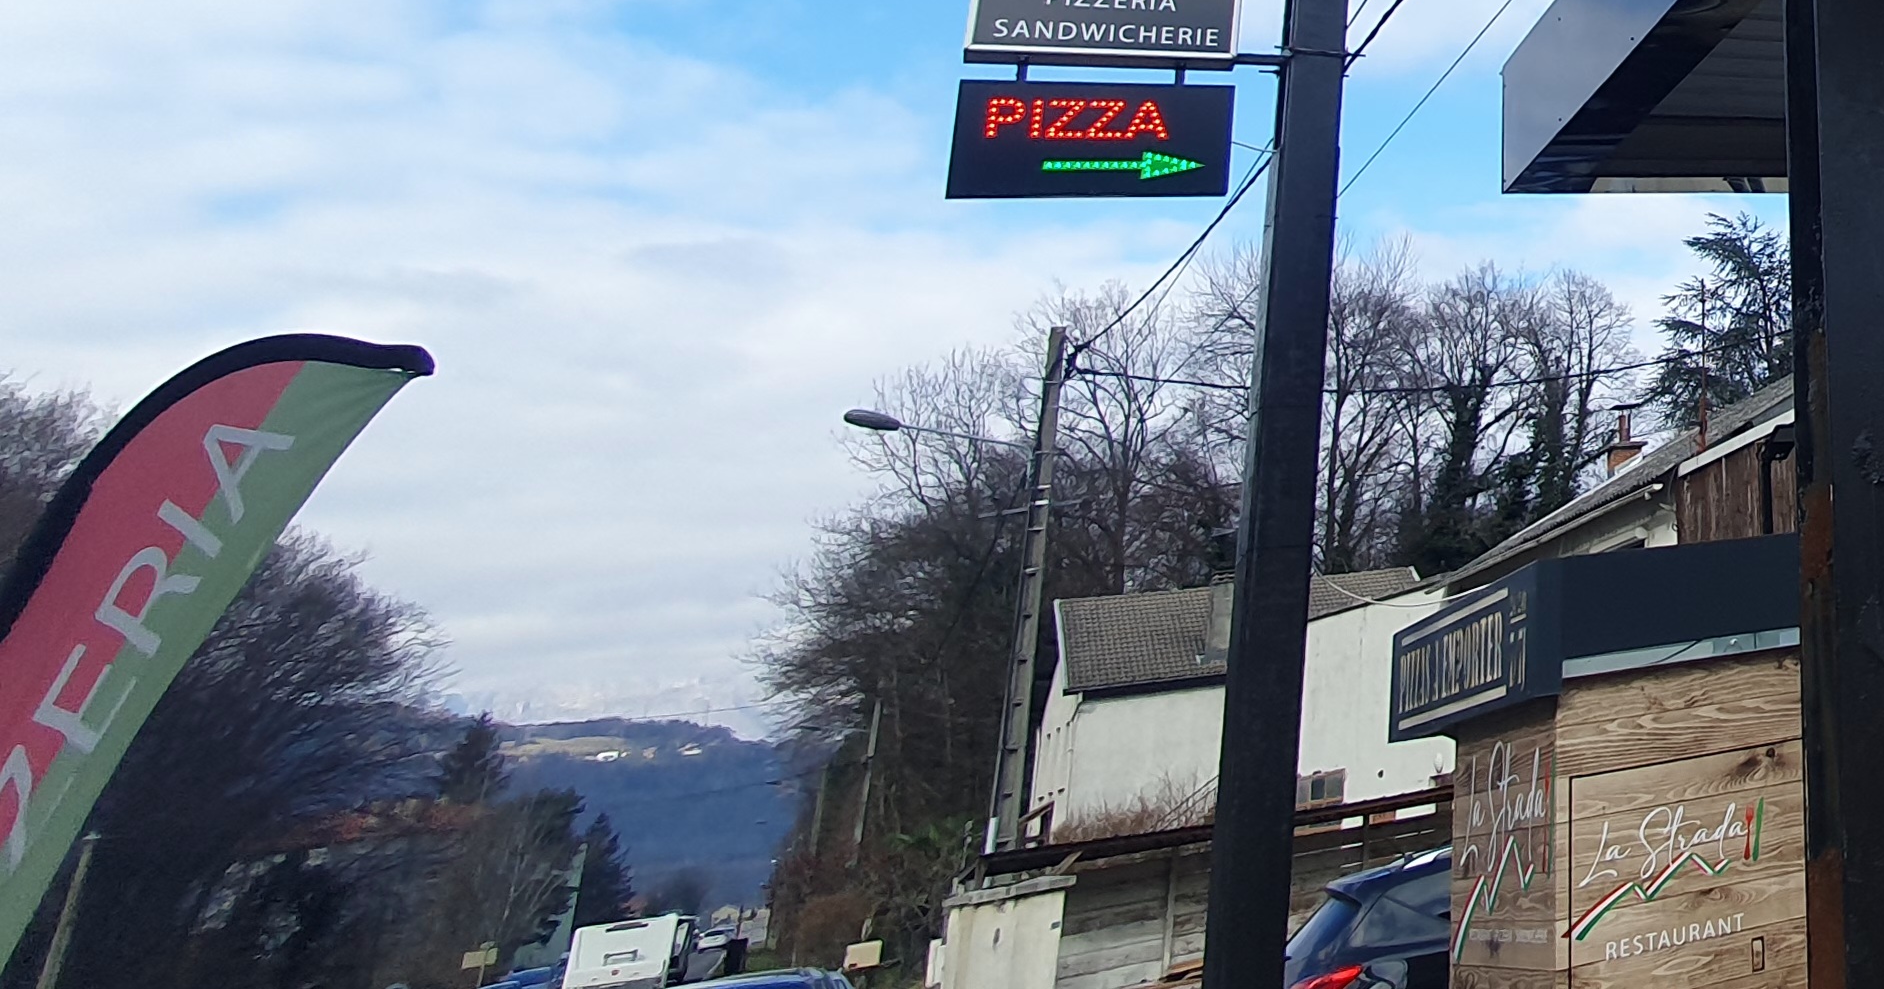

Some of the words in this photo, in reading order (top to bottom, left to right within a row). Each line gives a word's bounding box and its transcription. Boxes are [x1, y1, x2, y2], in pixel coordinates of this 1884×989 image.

[992, 18, 1221, 47] SANDWICHERIE
[982, 97, 1171, 141] PIZZA
[1441, 611, 1503, 699] EMPORTER
[1459, 754, 1486, 868] La
[1488, 740, 1546, 873] Strada
[1578, 820, 1632, 888] La
[1639, 801, 1750, 880] Strada
[1605, 912, 1745, 961] RESTAURANT
